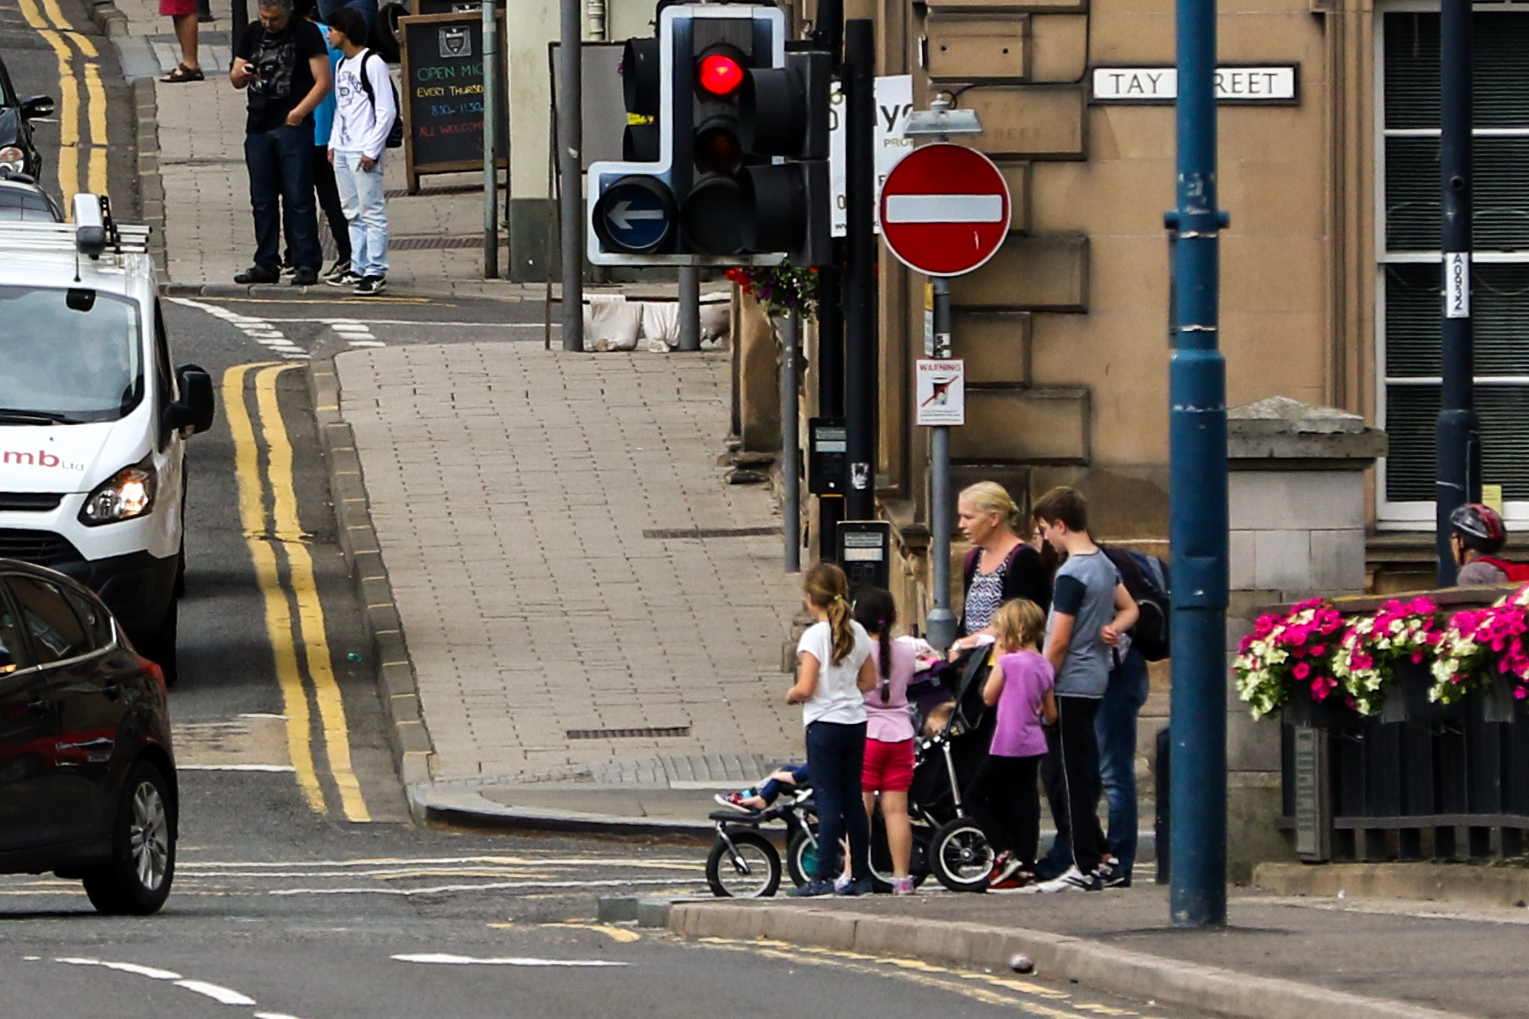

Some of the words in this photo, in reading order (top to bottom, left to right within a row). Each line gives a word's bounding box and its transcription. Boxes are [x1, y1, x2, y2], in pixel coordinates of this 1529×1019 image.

[417, 66, 456, 81] OPEN
[417, 86, 444, 98] EVERY
[449, 83, 485, 97] THURSD
[1108, 72, 1163, 95] TAY
[1214, 72, 1279, 95] REET
[919, 363, 962, 372] WARNING
[61, 460, 85, 472] Ltd
